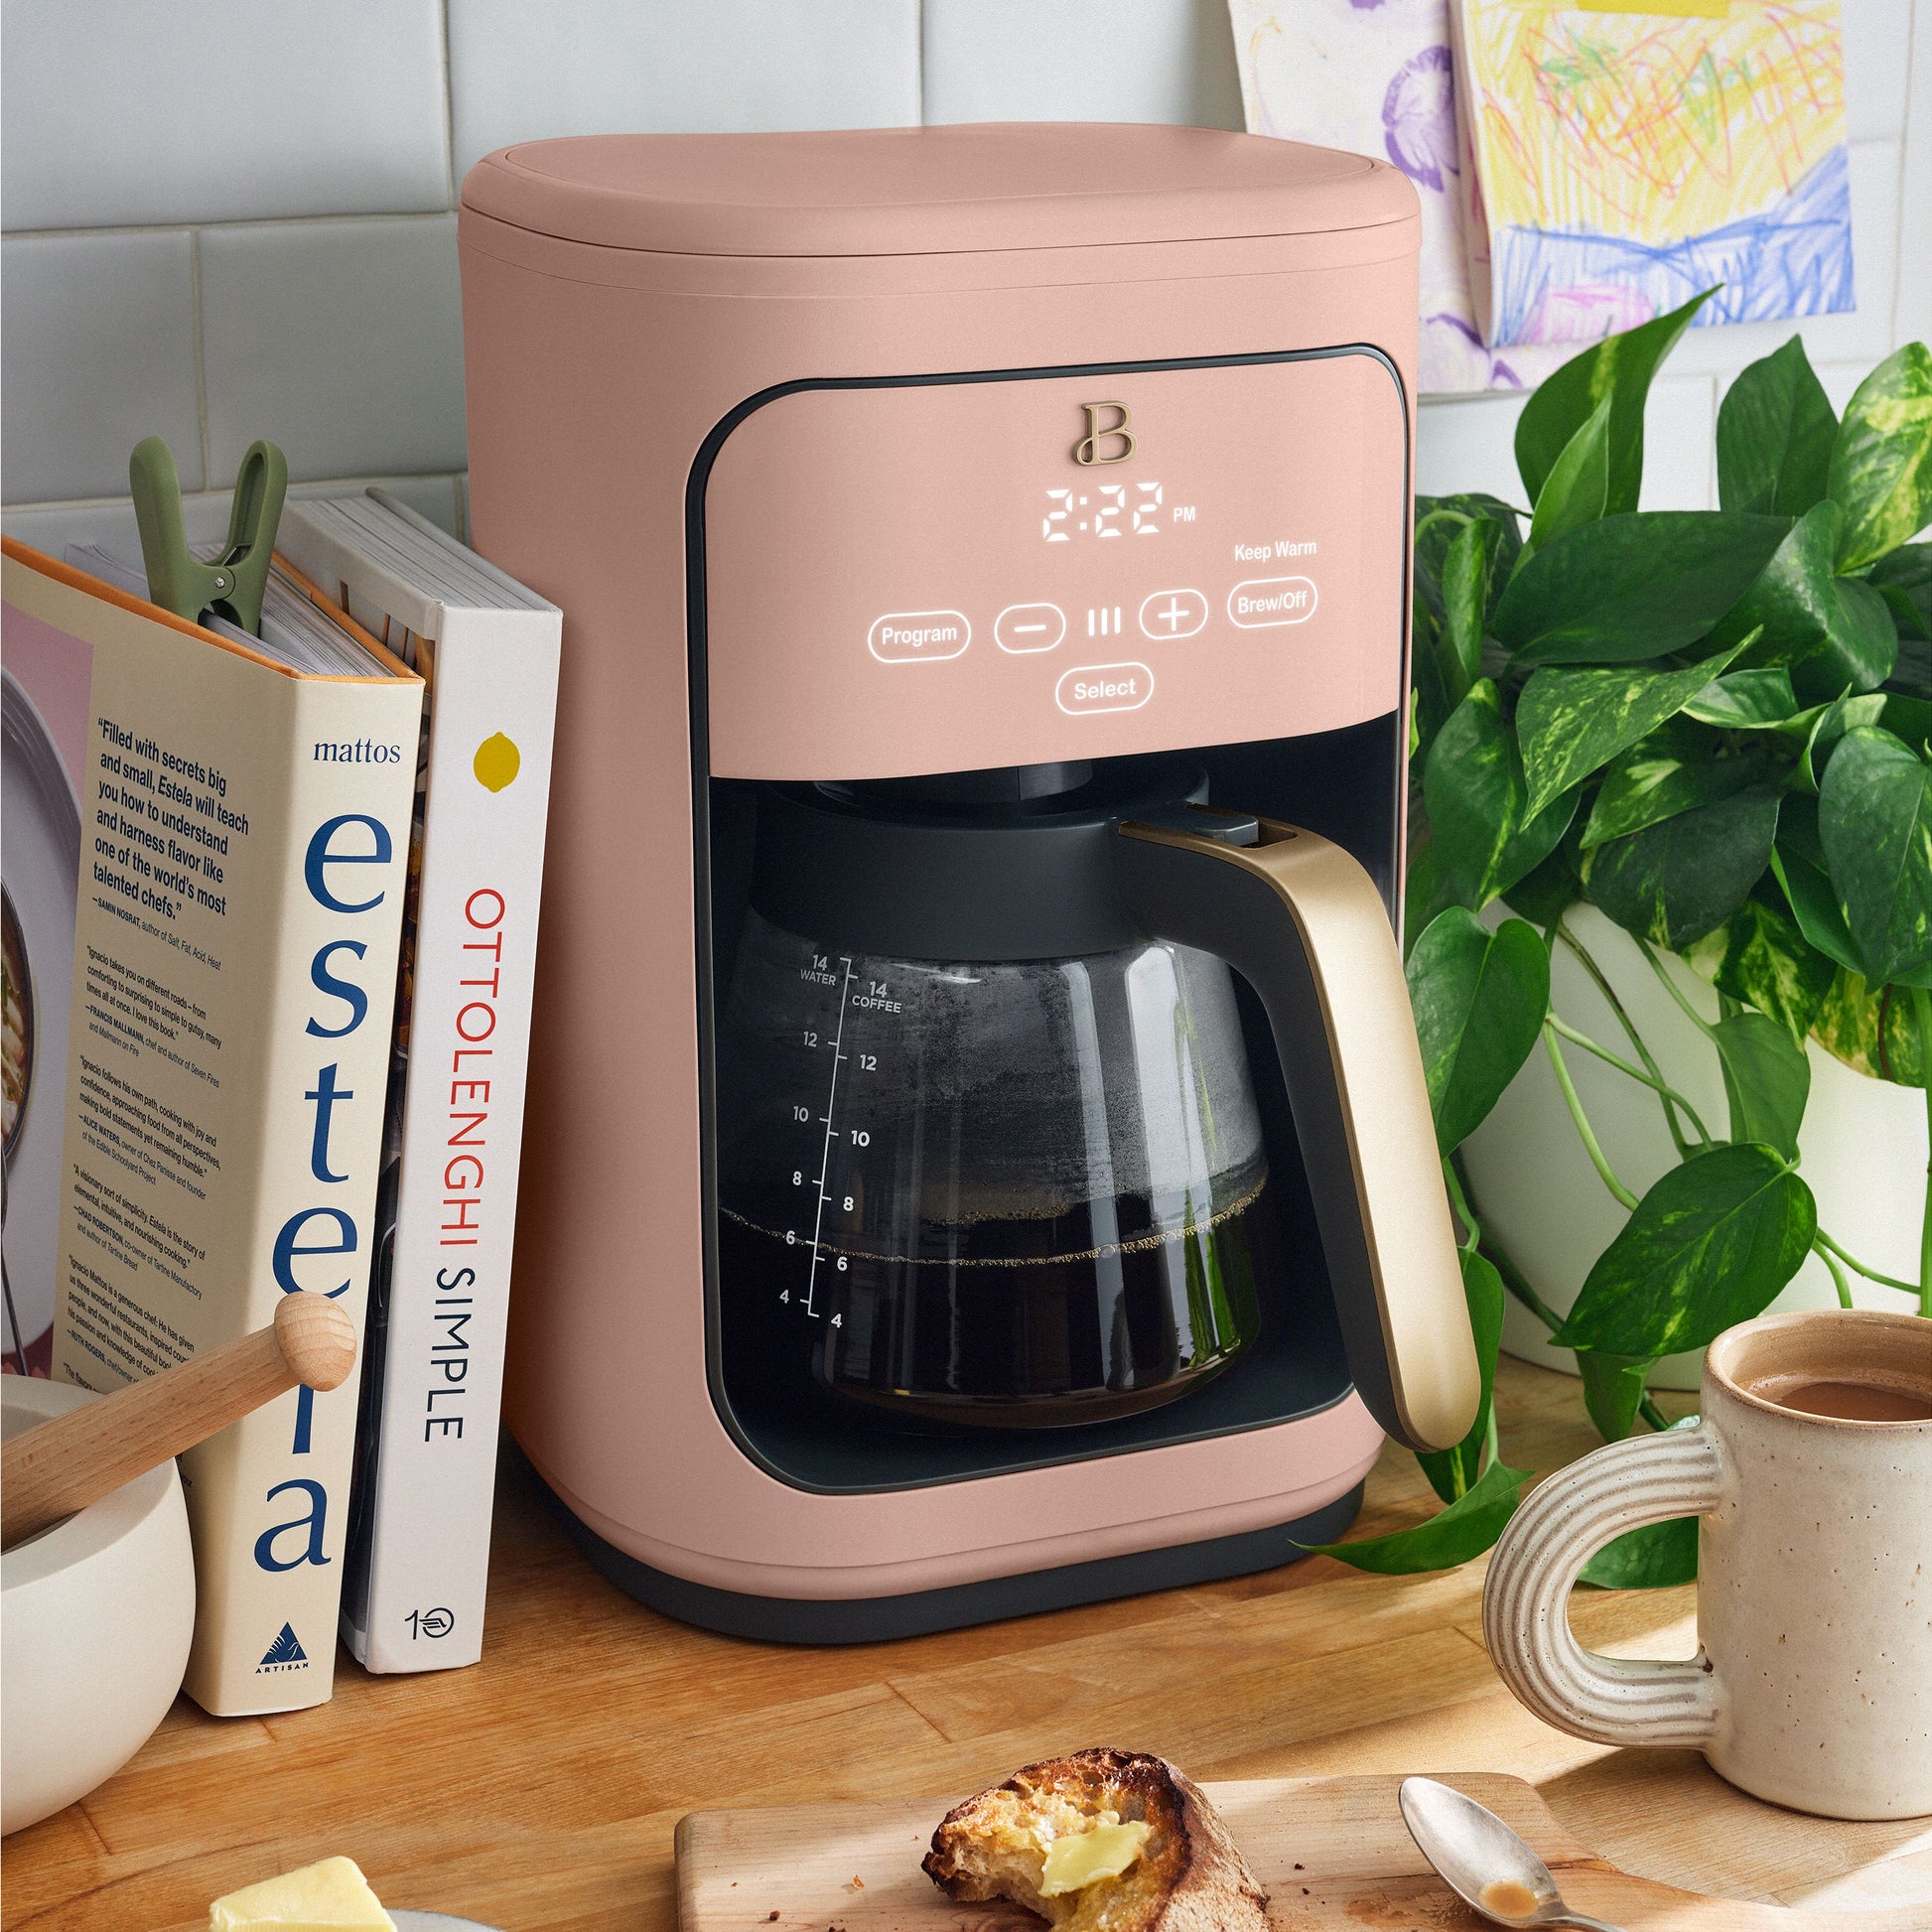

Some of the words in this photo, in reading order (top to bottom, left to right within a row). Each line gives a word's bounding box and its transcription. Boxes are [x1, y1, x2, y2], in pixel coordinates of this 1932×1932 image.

[1072, 400, 1138, 467] B
[1042, 483, 1163, 542] 2:22
[1173, 506, 1195, 522] PM
[1234, 543, 1272, 563] Keep
[1275, 540, 1316, 558] Warm
[1237, 592, 1308, 615] Brew/Off
[882, 625, 957, 647] Program
[1074, 678, 1136, 699] Select
[314, 738, 401, 763] mattos
[135, 738, 159, 762] with
[161, 751, 205, 783] secrets
[207, 766, 226, 797] big
[100, 753, 120, 774] and
[122, 762, 155, 794] small,
[157, 774, 192, 808] Estela
[195, 795, 214, 818] will
[217, 802, 248, 835] teach
[98, 780, 118, 802] you
[120, 785, 144, 814] how
[147, 799, 159, 821] to
[161, 810, 228, 856] understand
[96, 809, 117, 831] and
[119, 814, 164, 854] harness
[168, 838, 201, 872] flavor
[203, 855, 223, 884] like
[93, 861, 139, 900] talented
[94, 837, 115, 859] one
[117, 847, 130, 866] of
[132, 851, 151, 877] the
[197, 888, 225, 916] most
[812, 955, 828, 971] 14
[800, 969, 836, 986] WATER
[870, 981, 888, 999] 14
[852, 995, 901, 1014] COFFEE
[803, 1032, 818, 1047] 12
[439, 889, 506, 1245] OTTOLENGHI
[860, 1054, 878, 1071] 12
[792, 1106, 808, 1122] 10
[851, 1130, 870, 1147] 10
[792, 1172, 802, 1185] 8
[843, 1197, 854, 1211] 8
[786, 1231, 795, 1245] 6
[837, 1257, 848, 1271] 6
[779, 1290, 789, 1304] 4
[831, 1313, 842, 1328] 4
[425, 1267, 475, 1442] SIMPLE
[256, 1661, 310, 1674] ARTISAN
